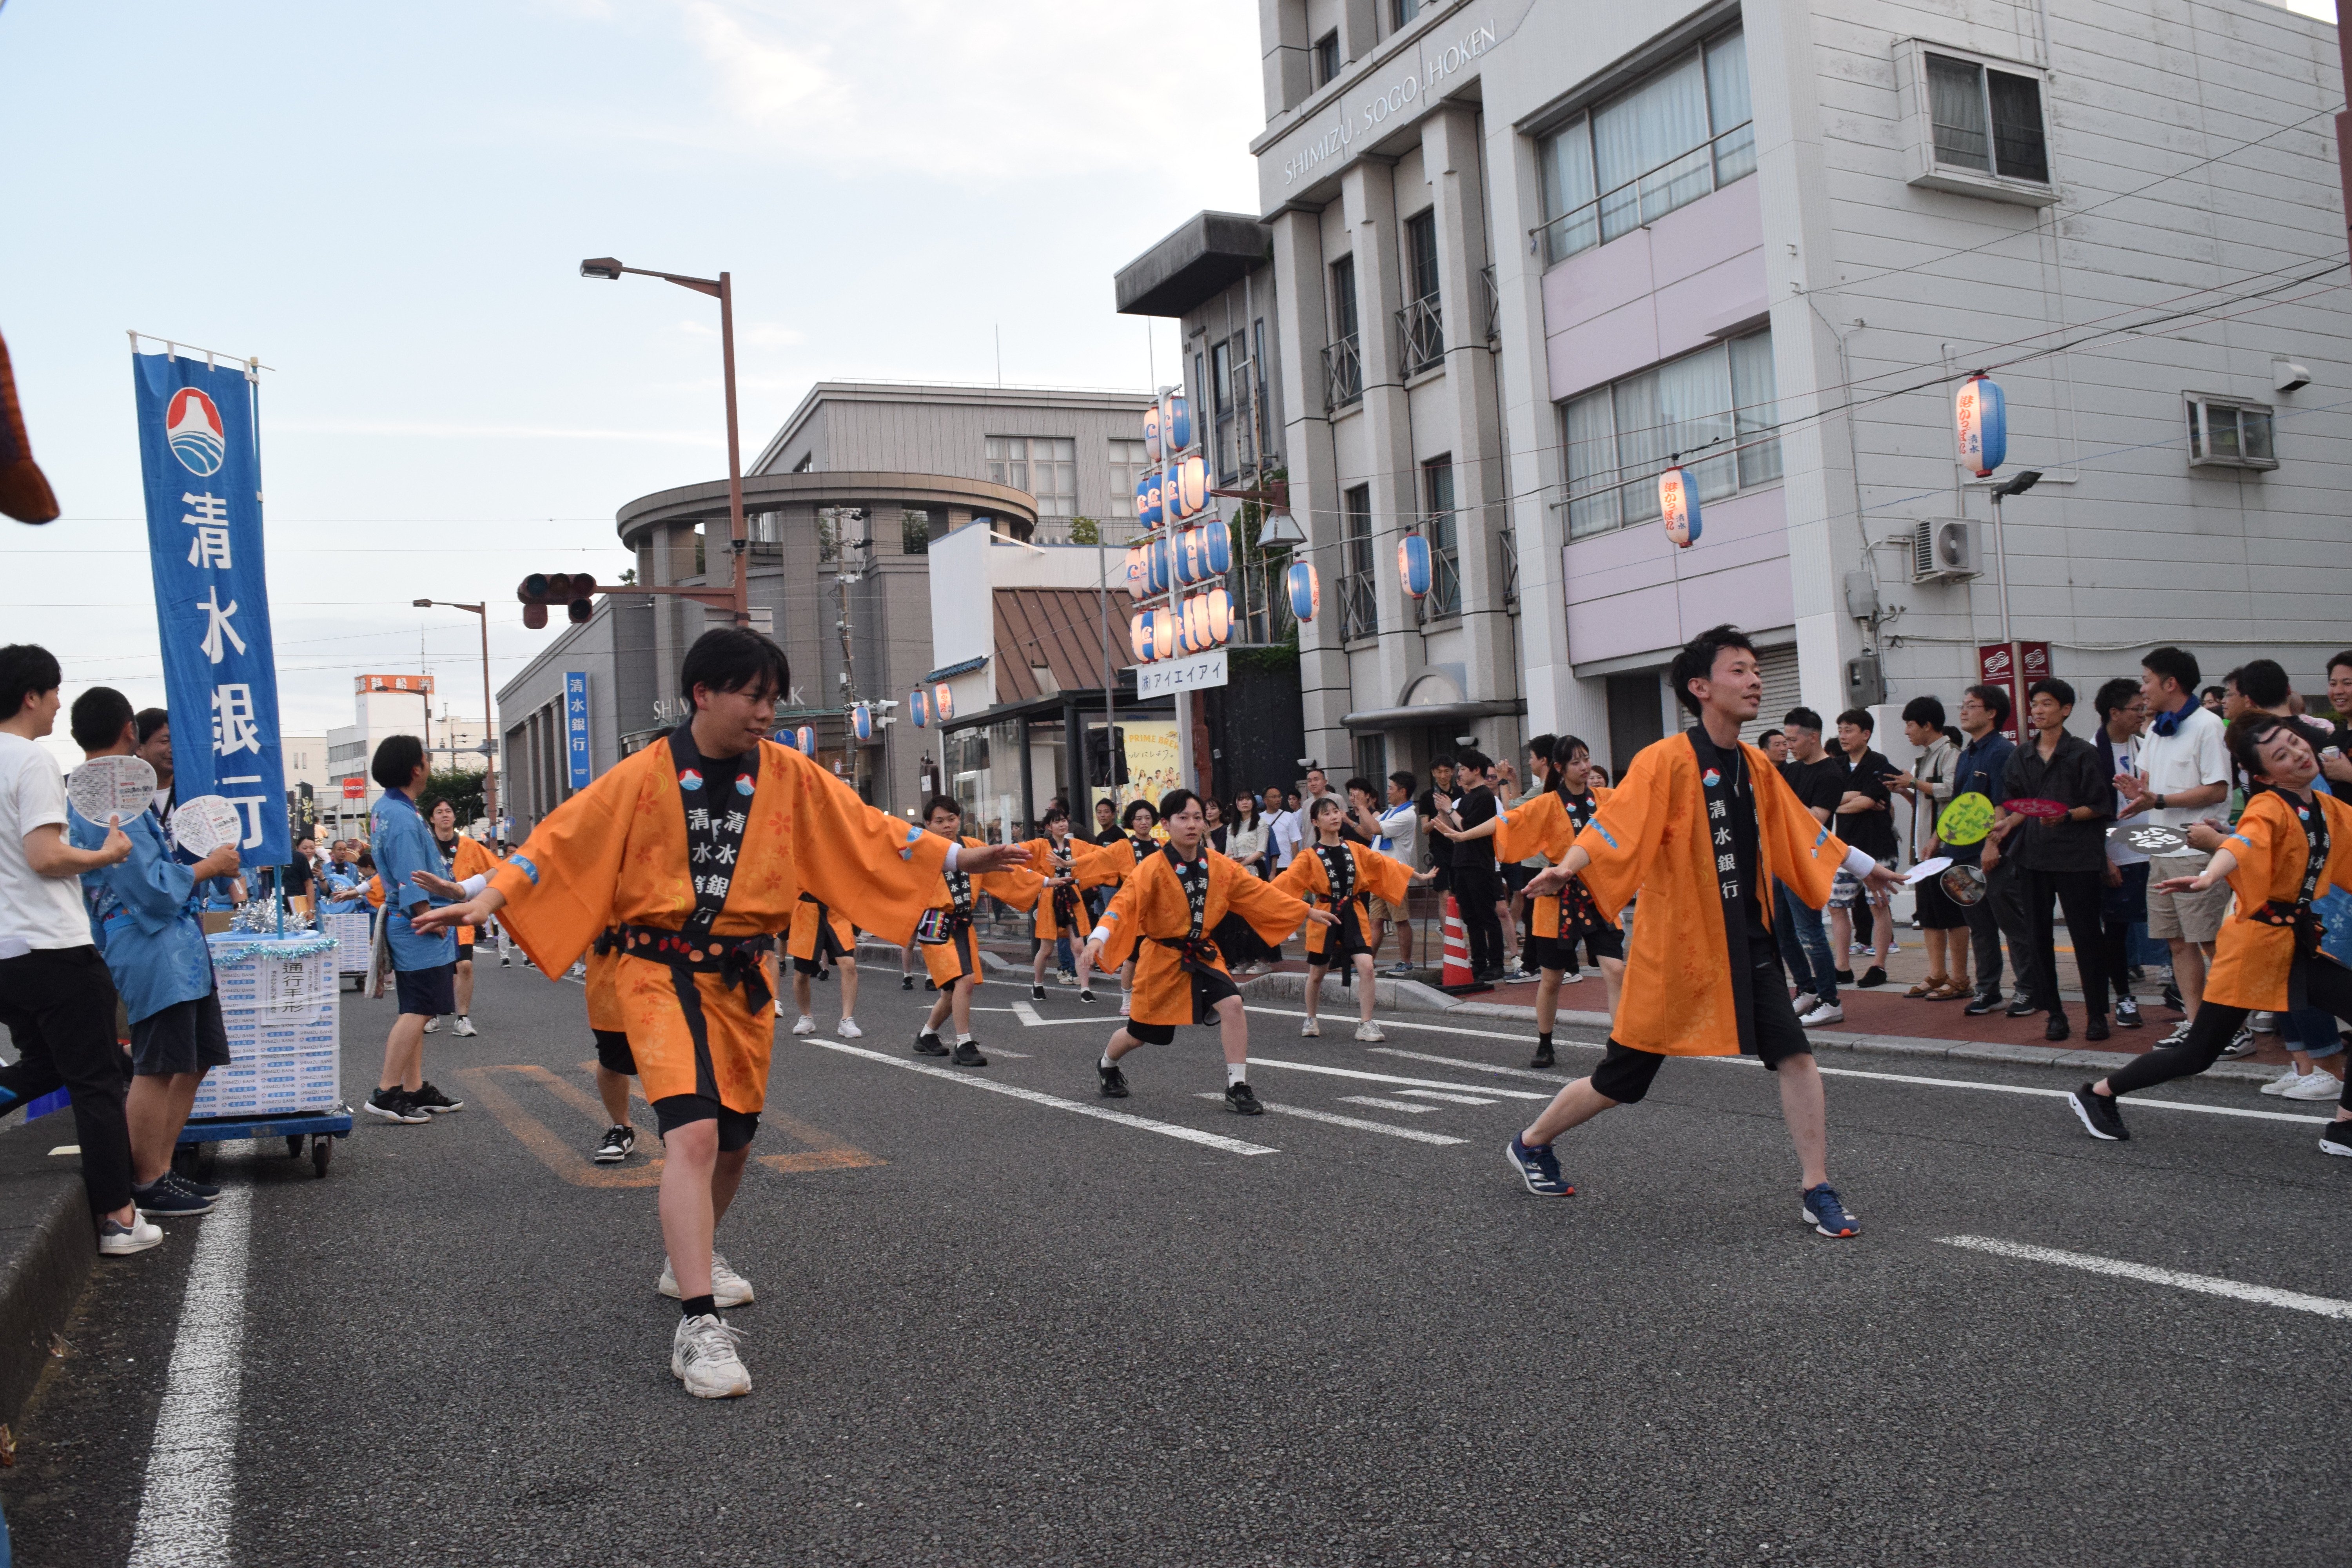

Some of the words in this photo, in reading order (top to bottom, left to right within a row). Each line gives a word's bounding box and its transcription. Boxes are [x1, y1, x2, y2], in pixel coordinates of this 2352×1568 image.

[1284, 118, 1353, 185] SHIMIZU
[1365, 76, 1417, 130] SOGO
[1429, 19, 1497, 85] HOKEN
[1968, 434, 1980, 453] 清水
[1664, 482, 1678, 530] 港かっぽれ
[1676, 514, 1686, 529] 清水
[181, 492, 267, 850] 清水銀行
[570, 679, 586, 751] 清水銀行
[693, 810, 746, 924] 清水銀行
[1344, 853, 1355, 896] 清水銀行
[1709, 800, 1739, 899] 清水銀行
[1323, 858, 1340, 899] 清水銀行
[1190, 877, 1207, 938] 清水銀行
[282, 963, 304, 1012] 通行手形
